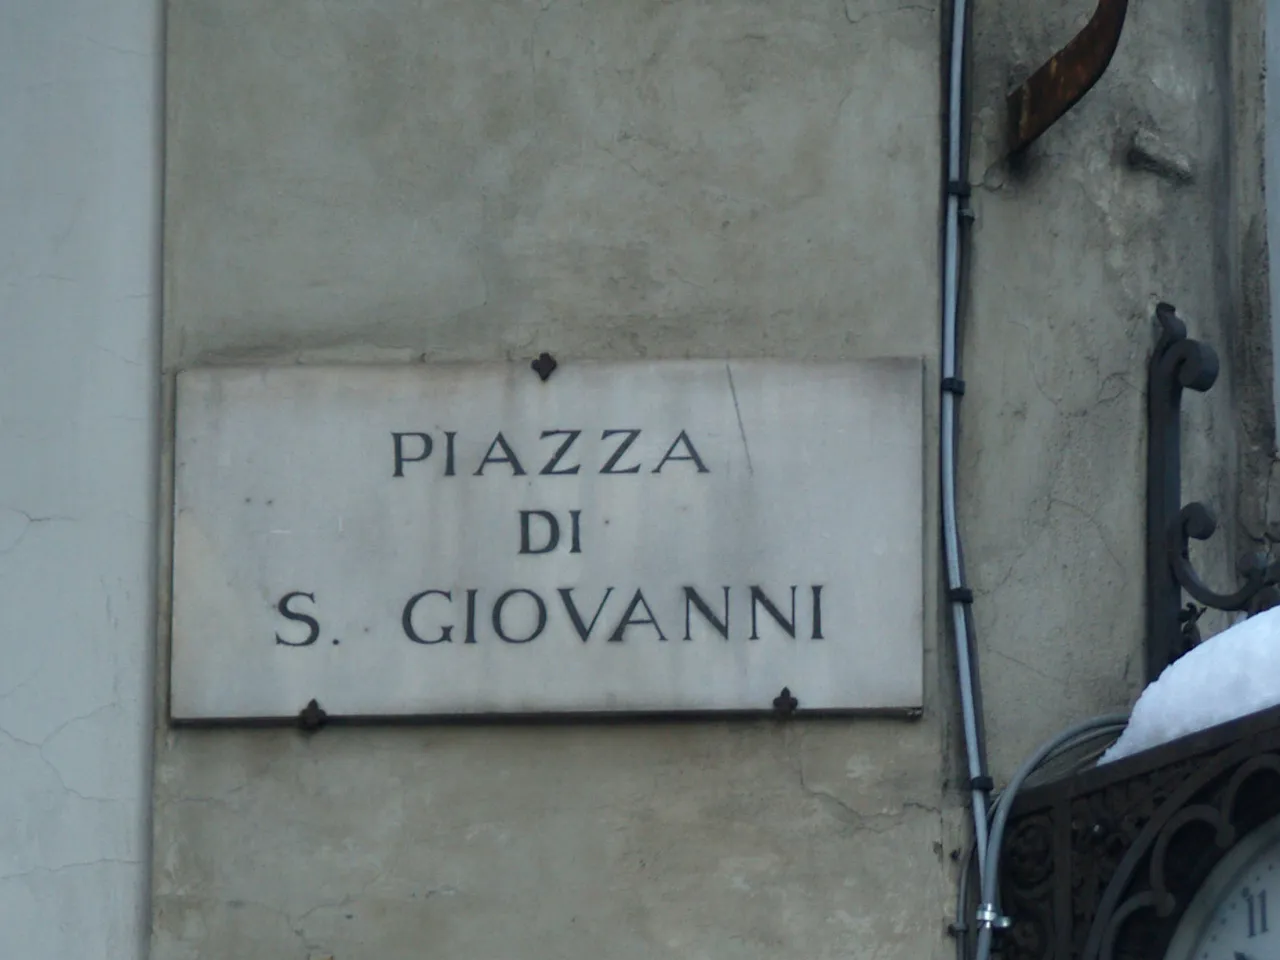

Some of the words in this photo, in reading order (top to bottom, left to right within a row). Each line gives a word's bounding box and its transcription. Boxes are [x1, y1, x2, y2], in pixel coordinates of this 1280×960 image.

[391, 429, 709, 477] PIAZZA
[519, 510, 582, 554] DI
[275, 591, 340, 647] S.
[402, 585, 825, 644] GIOVANNI
[1246, 889, 1270, 939] 11
